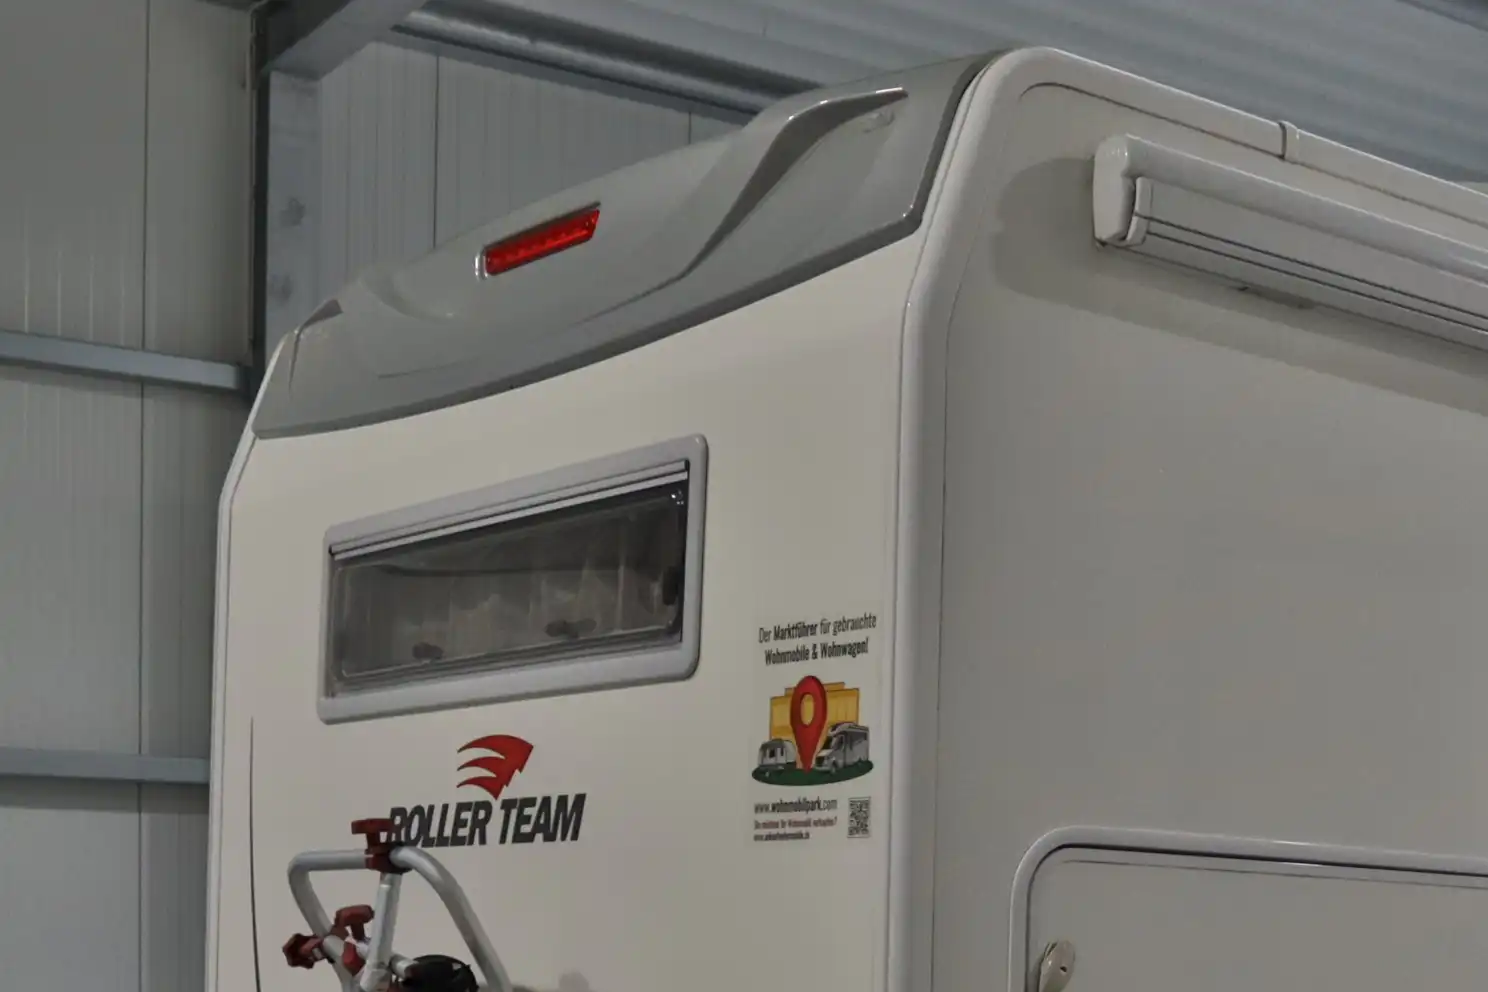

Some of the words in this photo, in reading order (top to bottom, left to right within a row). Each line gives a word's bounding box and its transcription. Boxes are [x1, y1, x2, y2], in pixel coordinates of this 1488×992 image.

[758, 627, 772, 643] Der
[773, 621, 818, 641] Marktführer
[820, 618, 832, 635] für
[833, 612, 877, 635] gebrauchte
[764, 645, 810, 666] Wohnmobile
[812, 643, 819, 660] &
[389, 800, 493, 849] ROLLER
[498, 793, 587, 845] TEAM
